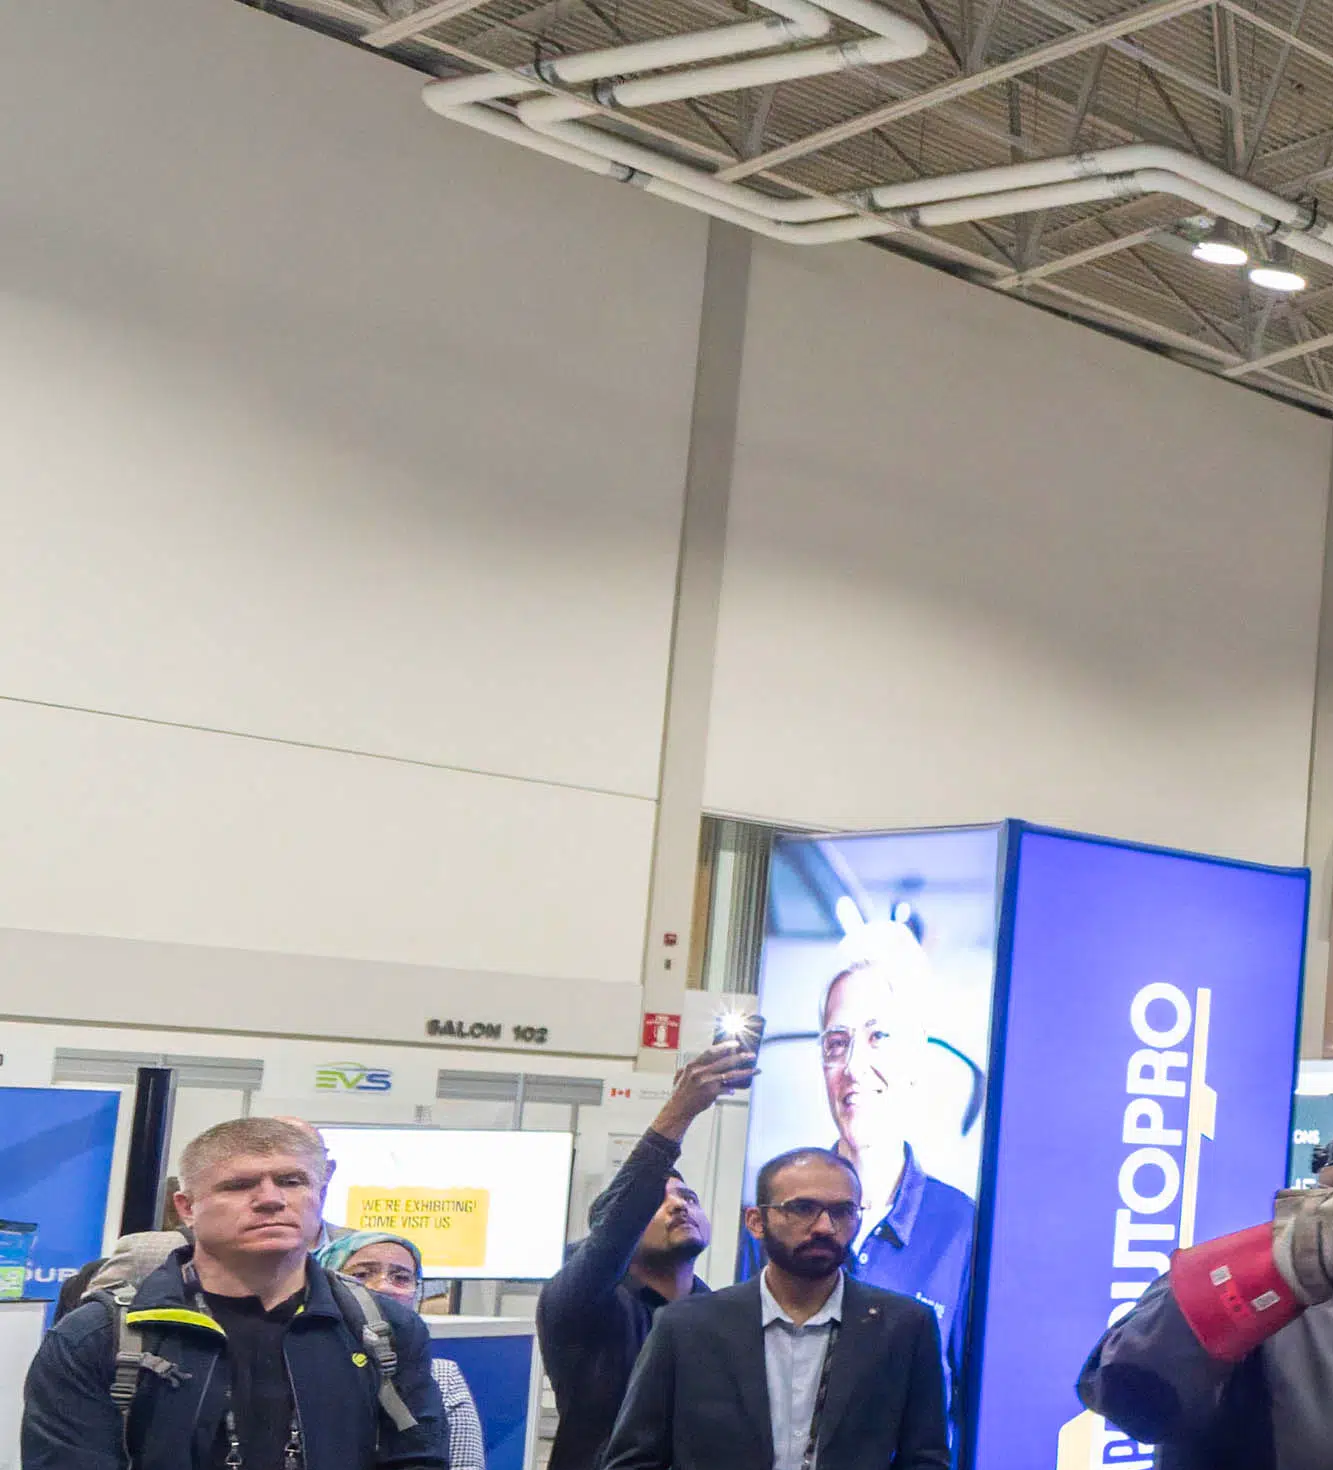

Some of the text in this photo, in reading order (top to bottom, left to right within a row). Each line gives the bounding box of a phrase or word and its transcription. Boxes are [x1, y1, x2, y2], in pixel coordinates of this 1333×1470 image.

[426, 1019, 502, 1040] SALON
[316, 1068, 392, 1092] EVS
[1108, 982, 1192, 1329] UTOPRO
[360, 1214, 452, 1230] COME VISIT US
